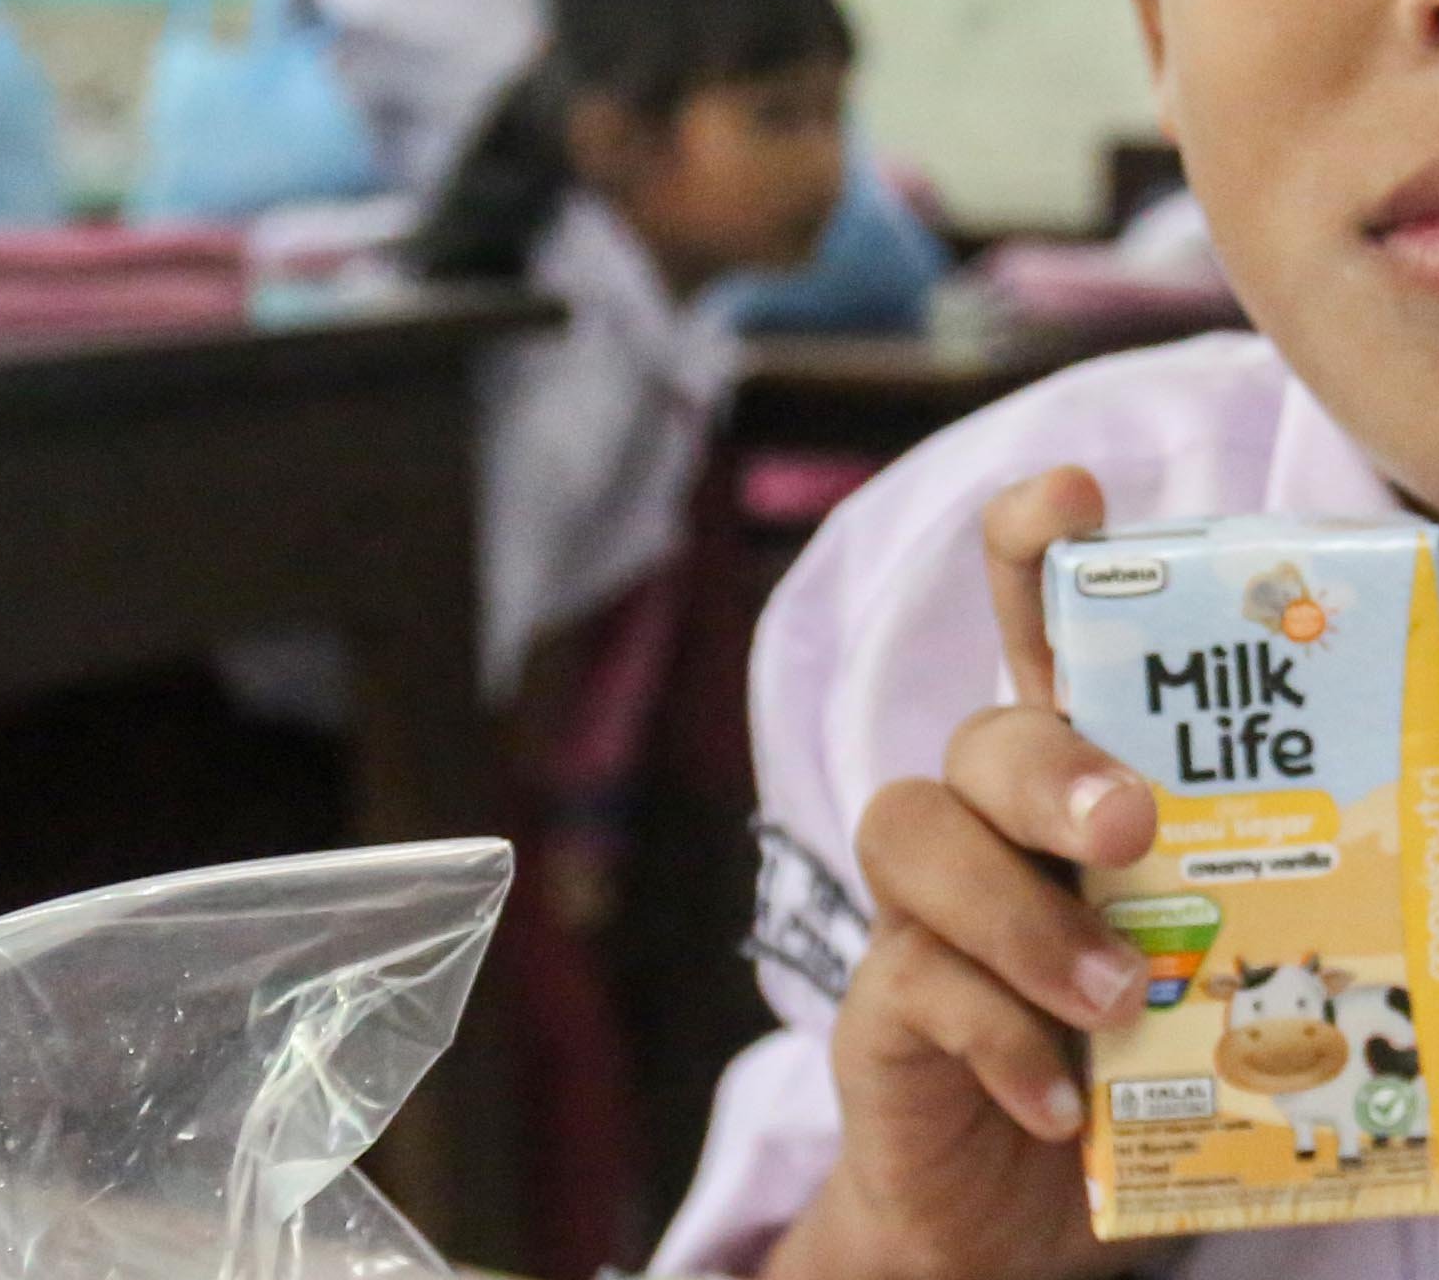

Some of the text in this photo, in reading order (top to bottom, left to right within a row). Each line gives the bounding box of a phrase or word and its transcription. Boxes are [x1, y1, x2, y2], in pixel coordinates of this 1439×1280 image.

[1145, 641, 1306, 715] Milk
[1175, 712, 1316, 784] Life
[1187, 851, 1332, 878] creamy vanilla
